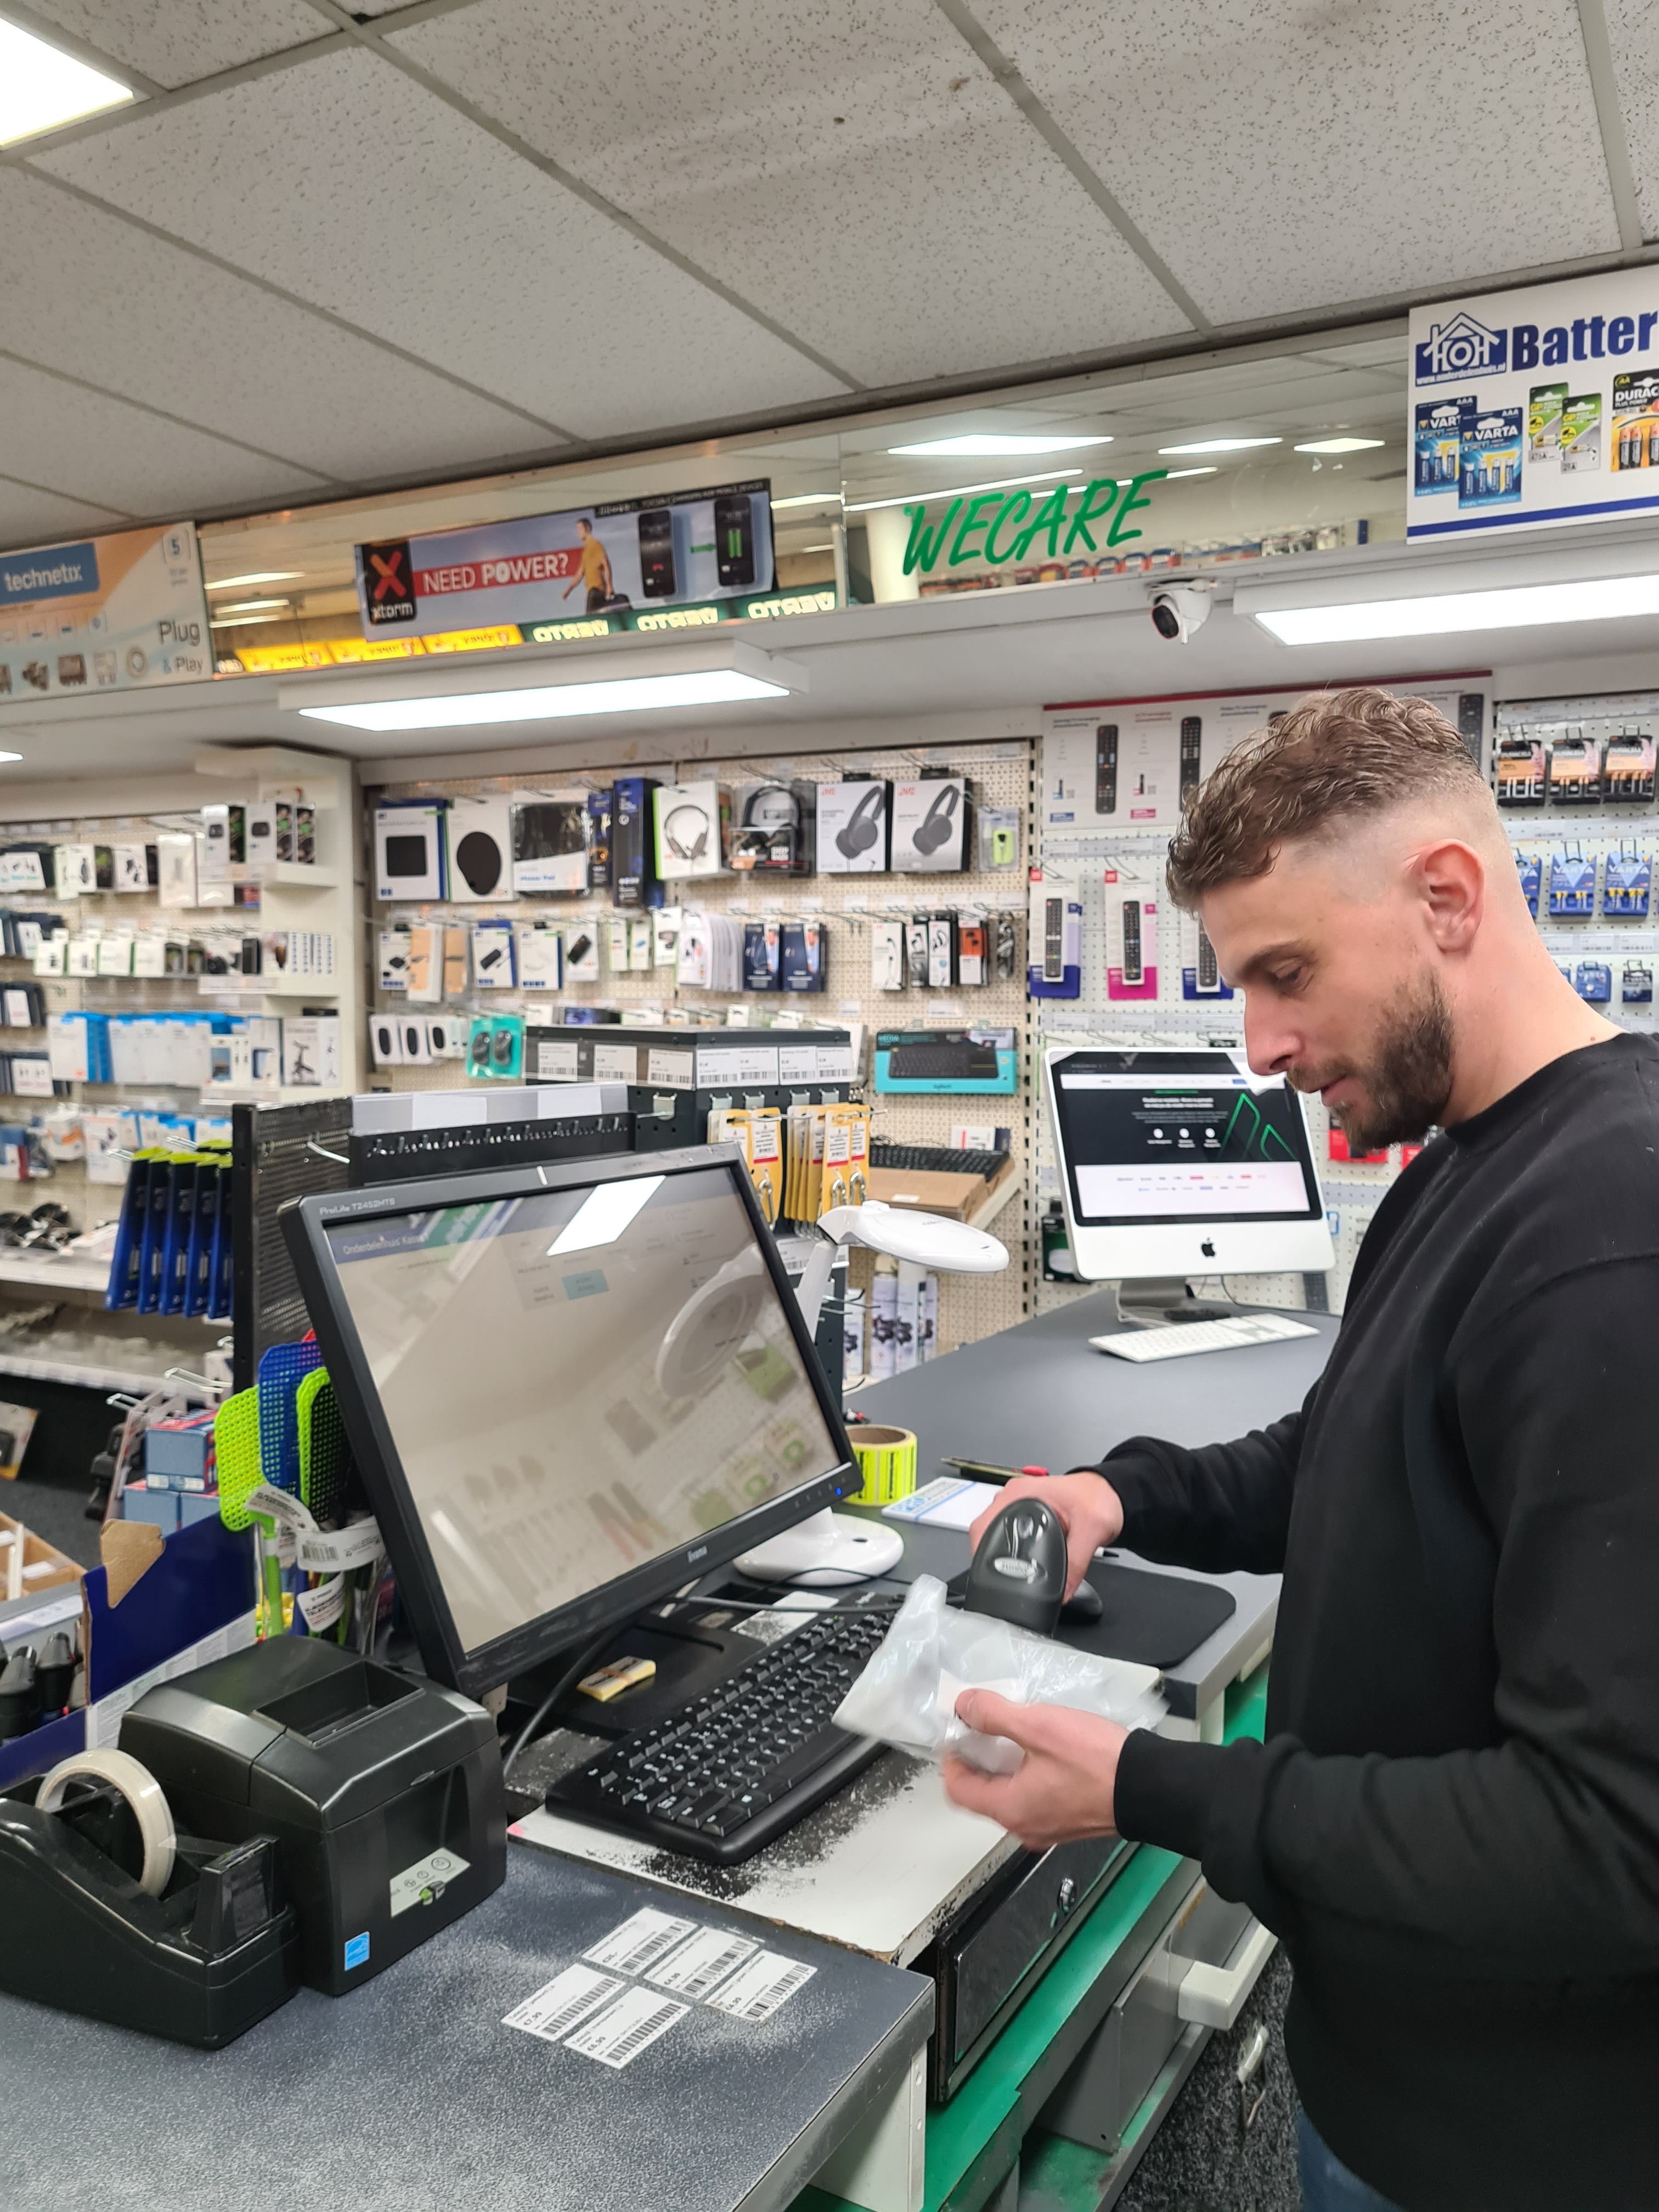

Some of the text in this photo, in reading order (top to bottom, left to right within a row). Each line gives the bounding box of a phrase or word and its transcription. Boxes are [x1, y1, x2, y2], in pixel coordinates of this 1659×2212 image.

[1430, 415, 1460, 428] VART
[1475, 425, 1518, 441] VARTA
[422, 552, 569, 594] NEED POWER?
[370, 601, 413, 619] xtorm
[157, 619, 201, 647] Plug
[175, 654, 204, 674] Play
